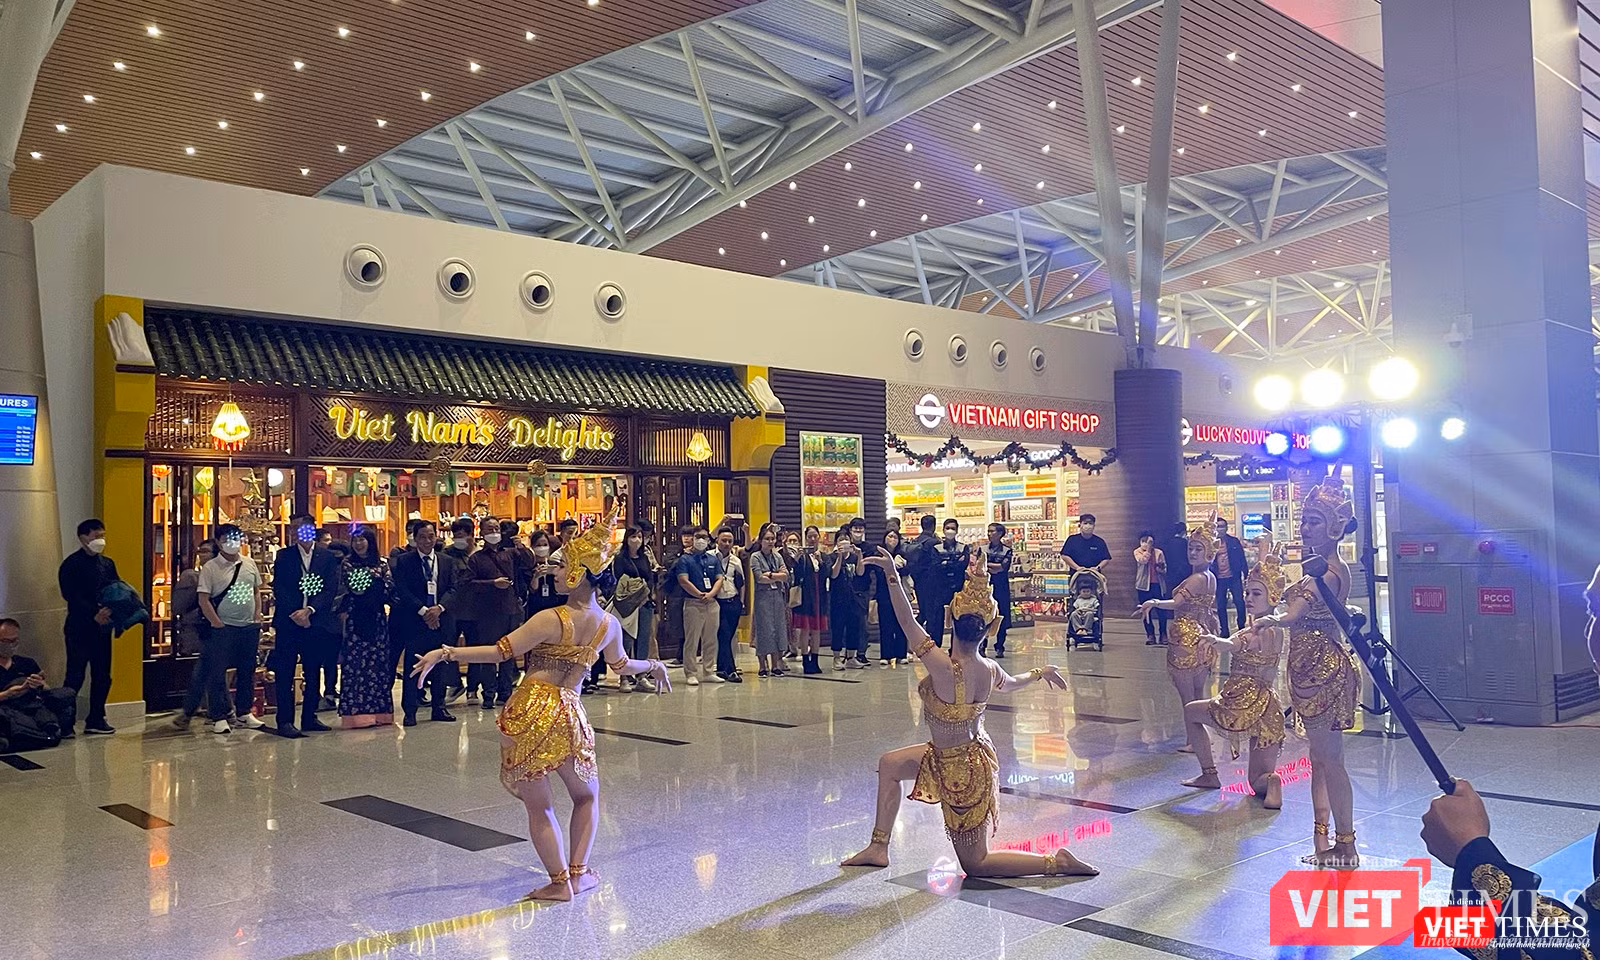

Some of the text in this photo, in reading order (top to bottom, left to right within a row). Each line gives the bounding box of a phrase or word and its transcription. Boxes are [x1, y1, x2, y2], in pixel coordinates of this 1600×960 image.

[949, 403, 1100, 433] VIETNAM GIFT SHOP
[328, 405, 616, 462] Viet Nam's Delights
[1196, 424, 1232, 443] LUCKY
